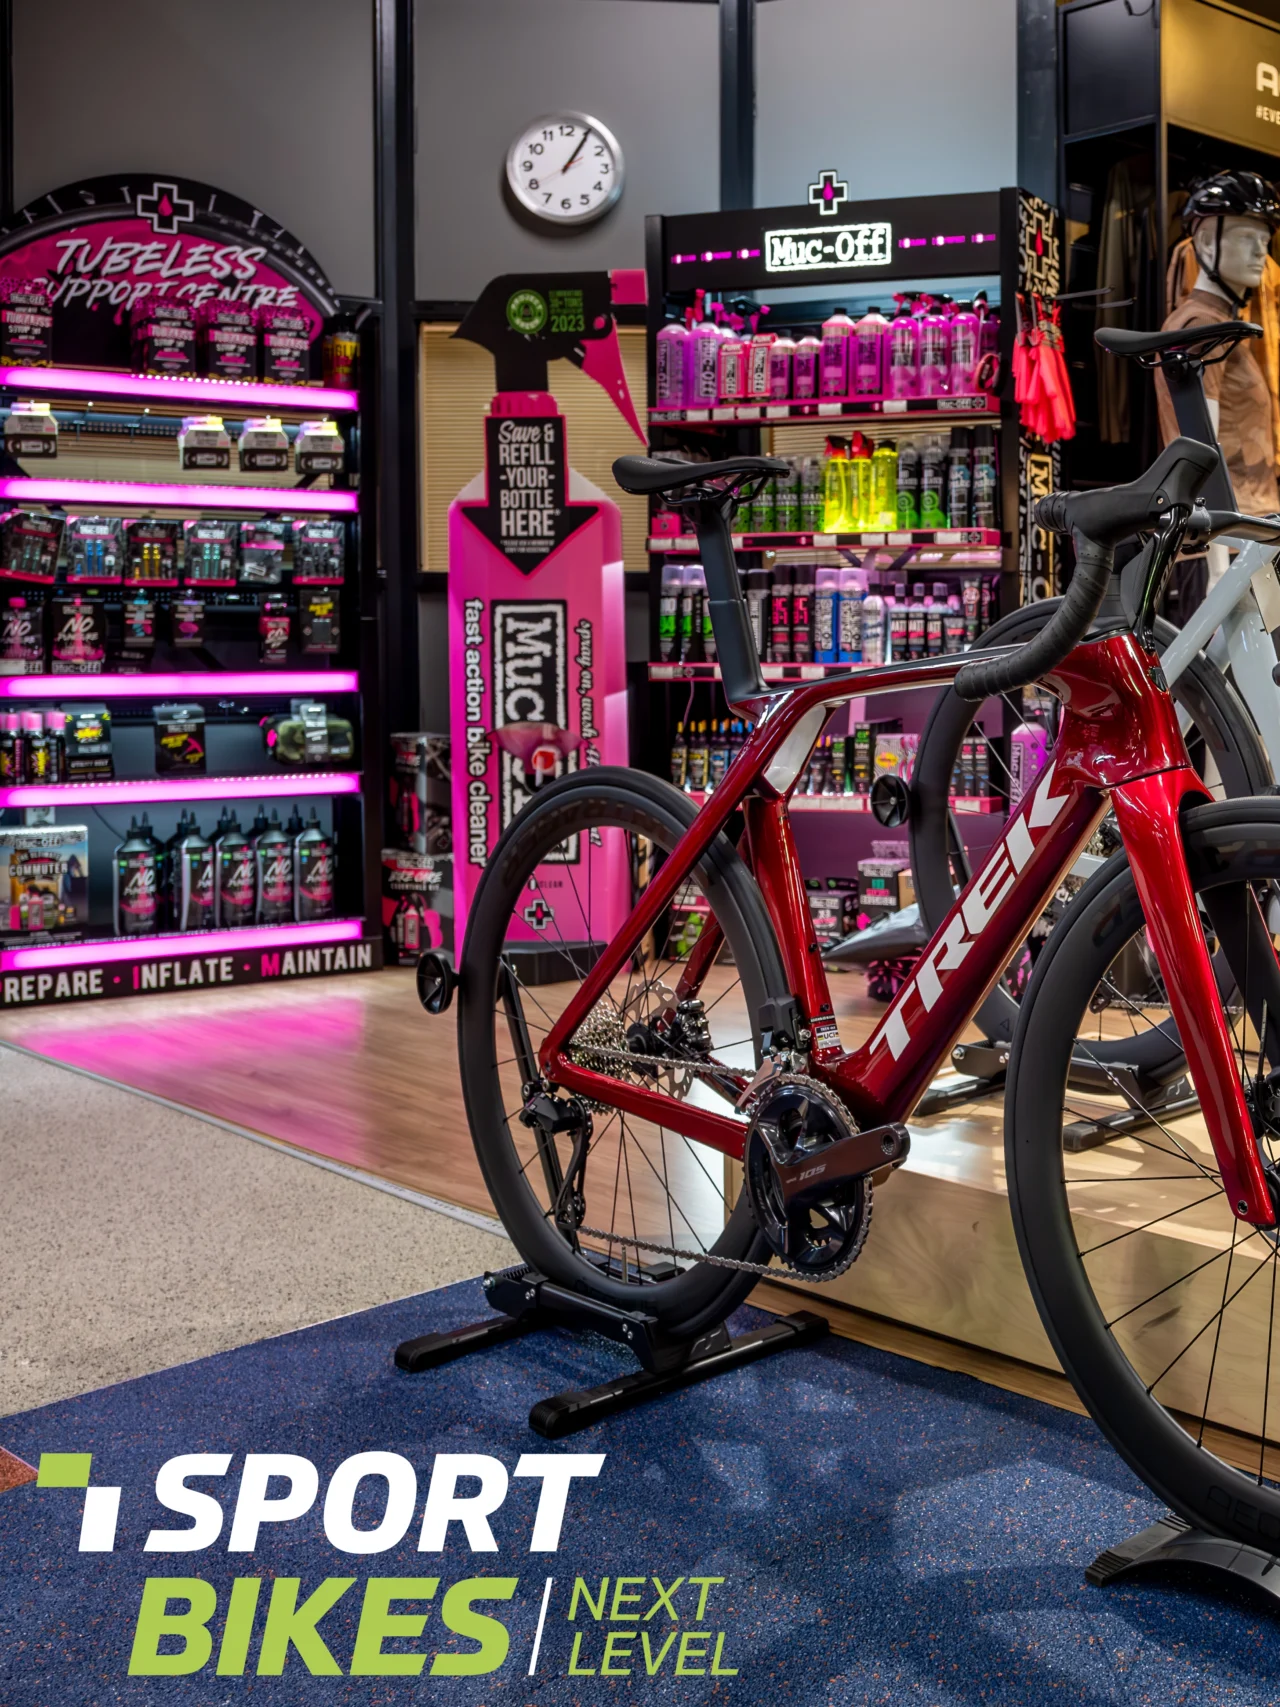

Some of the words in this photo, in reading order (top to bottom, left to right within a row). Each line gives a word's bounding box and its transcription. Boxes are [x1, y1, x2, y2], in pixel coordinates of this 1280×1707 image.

[542, 131, 554, 141] 11
[559, 126, 575, 137] 12
[529, 144, 544, 155] 10
[594, 146, 604, 156] 2
[523, 161, 533, 172] 9
[600, 164, 609, 174] 3
[529, 179, 539, 190] 8
[593, 181, 603, 191] 4
[543, 193, 553, 204] 7
[561, 199, 571, 210] 6
[580, 194, 590, 205] 5
[771, 230, 886, 267] Muc-Off
[55, 238, 267, 279] TUBELESS
[550, 315, 585, 332] 2023
[498, 420, 541, 443] Save
[544, 423, 555, 443] &
[499, 443, 555, 465] REFILL
[500, 489, 554, 508] BOTTLE
[63, 615, 95, 633] NO
[464, 598, 485, 646] fast
[575, 619, 596, 669] spray
[464, 648, 485, 722] action
[578, 697, 600, 738] wash
[468, 780, 491, 868] cleaner
[9, 862, 68, 878] COMMUTER
[869, 760, 1069, 1061] TREK
[0, 968, 104, 1002] REPARE
[133, 956, 235, 991] INFLATE
[261, 944, 373, 978] MAINTAIN
[823, 1032, 837, 1040] UCI
